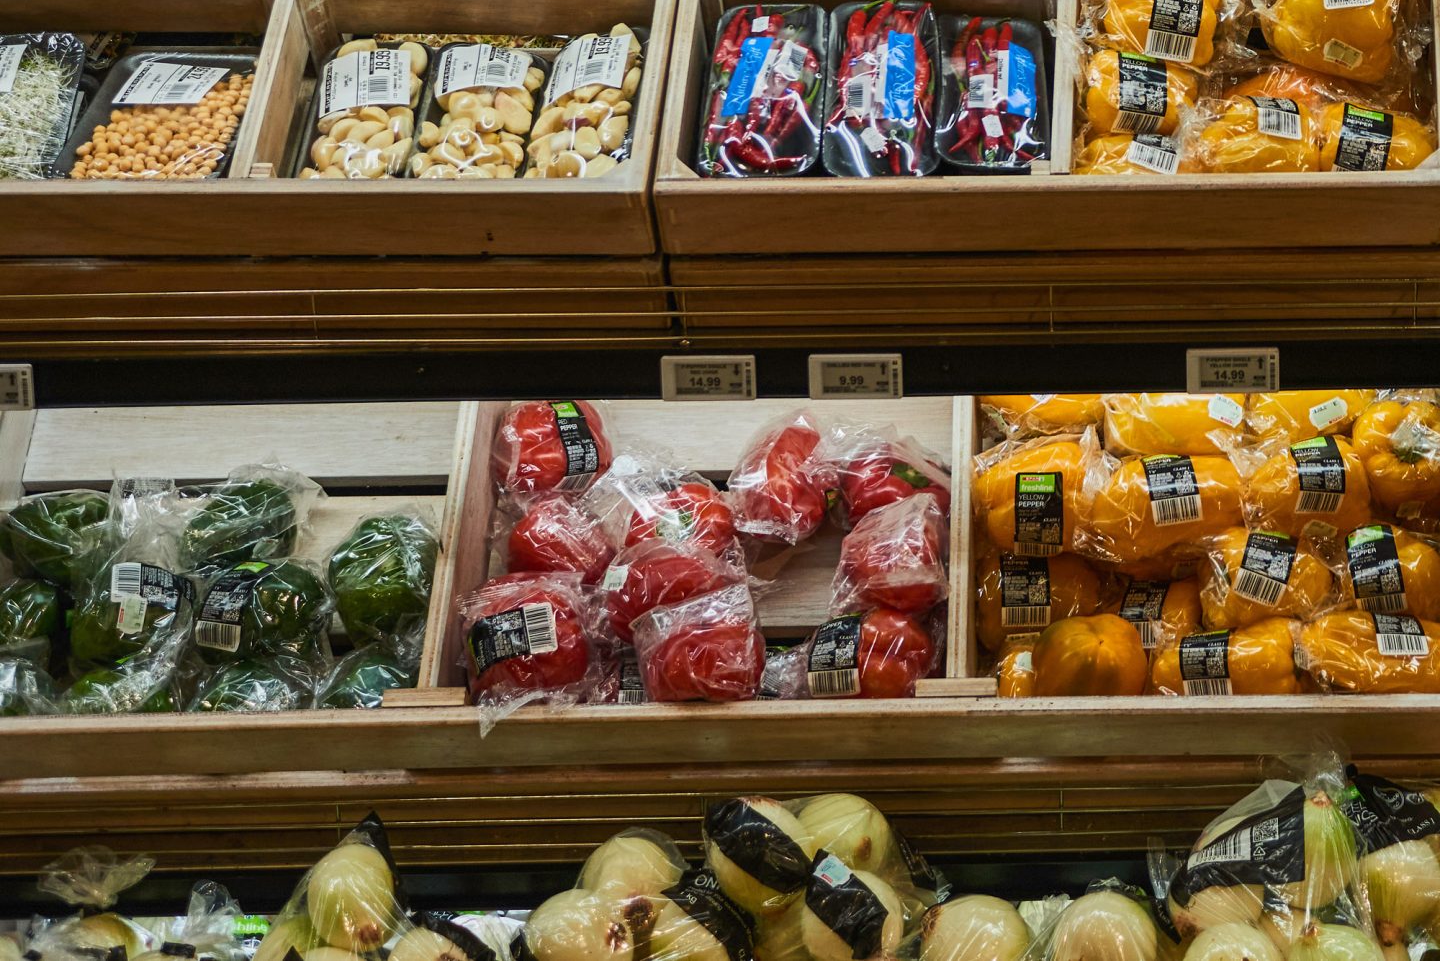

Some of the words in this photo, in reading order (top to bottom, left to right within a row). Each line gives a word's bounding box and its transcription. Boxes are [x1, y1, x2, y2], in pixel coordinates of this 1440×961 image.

[596, 36, 612, 55] 19.99
[376, 50, 390, 71] 19.99
[1122, 59, 1148, 67] YELLOW
[1122, 63, 1148, 71] PEPPER
[1346, 119, 1373, 127] PEPPER
[839, 375, 864, 385] 9.99
[1214, 370, 1245, 380] 14.99
[689, 377, 720, 387] 14.99
[1351, 548, 1376, 559] PEPPER
[1406, 819, 1430, 835] CLASS
